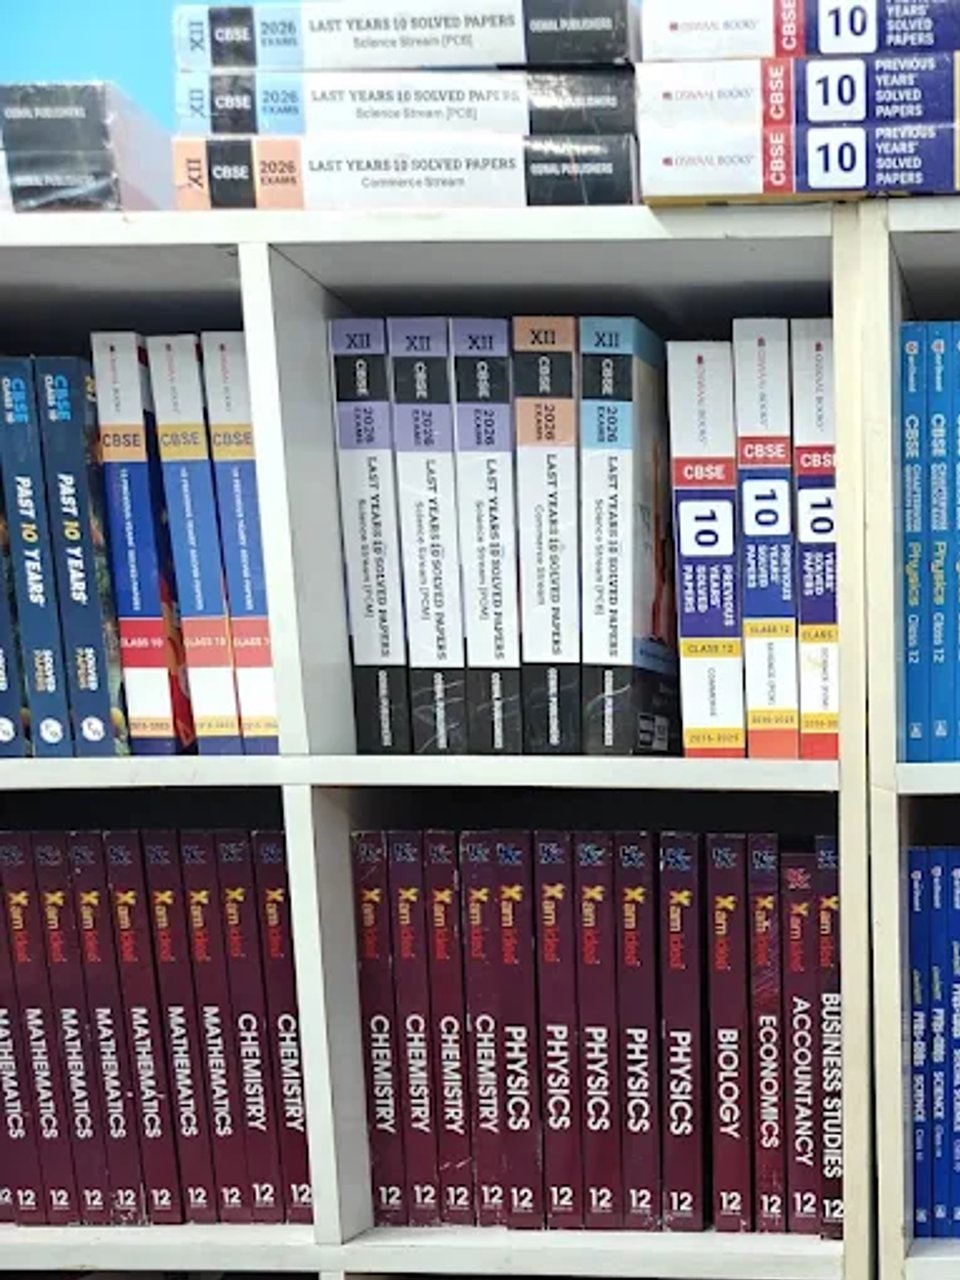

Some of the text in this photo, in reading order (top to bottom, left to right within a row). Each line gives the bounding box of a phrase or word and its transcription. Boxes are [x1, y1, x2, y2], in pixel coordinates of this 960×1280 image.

[261, 22, 296, 36] 2026
[309, 20, 342, 32] LAST
[346, 19, 390, 31] YEARS
[393, 18, 407, 31] 10
[411, 16, 462, 31] SOLVED
[465, 15, 515, 29] PAPERS
[782, 0, 796, 50] CBSE
[828, 6, 868, 37] 10
[215, 27, 251, 42] CBSE
[353, 36, 441, 49] Science Stream
[886, 34, 934, 46] PAPERS
[875, 58, 936, 71] PREVIOUS
[770, 65, 784, 119] CBSE
[816, 74, 856, 106] 10
[875, 91, 922, 102] SOLVED
[215, 95, 251, 110] CBSE
[875, 105, 923, 117] PAPERS
[875, 127, 936, 139] PREVIOUS
[260, 161, 296, 174] 2026
[309, 160, 342, 171] LAST
[346, 160, 390, 172] YEARS
[411, 159, 462, 171] SOLVED
[466, 158, 516, 170] PAPERS
[770, 132, 785, 186] CBSE
[816, 143, 857, 173] 10
[875, 157, 922, 169] SOLVED
[213, 165, 249, 180] CBSE
[261, 176, 297, 185] EXAMS
[361, 176, 465, 188] Commerce Stream
[875, 172, 923, 185] PAPERS
[469, 334, 493, 351] XII
[531, 329, 556, 345] XII
[594, 332, 619, 349] XII
[538, 357, 551, 393] CBSE
[601, 359, 614, 395] CBSE
[543, 405, 556, 441] 2026
[102, 434, 141, 447] CBSE
[906, 415, 918, 458] CBSE
[744, 443, 785, 458] CBSE
[684, 465, 725, 479] CBSE
[15, 476, 35, 519] PAST
[57, 473, 78, 517] PAST
[754, 488, 779, 527] 10
[20, 522, 38, 542] 10
[63, 521, 81, 540] 10
[693, 509, 718, 548] 10
[906, 541, 921, 606] Physics
[25, 1007, 58, 1139] MATHEMATICS
[96, 1007, 126, 1139] MATHEMATICS
[203, 1006, 233, 1138] MATHEMATICS
[238, 1013, 267, 1132] CHEMISTRY
[278, 1014, 304, 1132] CHEMISTRY
[370, 1014, 396, 1134] CHEMISTRY
[505, 1025, 530, 1131] PHYSICS
[585, 1026, 610, 1131] PHYSICS
[758, 1015, 779, 1148] ECONOMICS
[792, 997, 814, 1166] ACCOUNTANCY
[717, 1027, 740, 1138] BIOLOGY
[821, 993, 843, 1179] BUSINESS STUDIES
[188, 1188, 207, 1203] 12
[379, 1188, 401, 1204] 12
[630, 1189, 652, 1208] 12
[720, 1192, 741, 1209] 12
